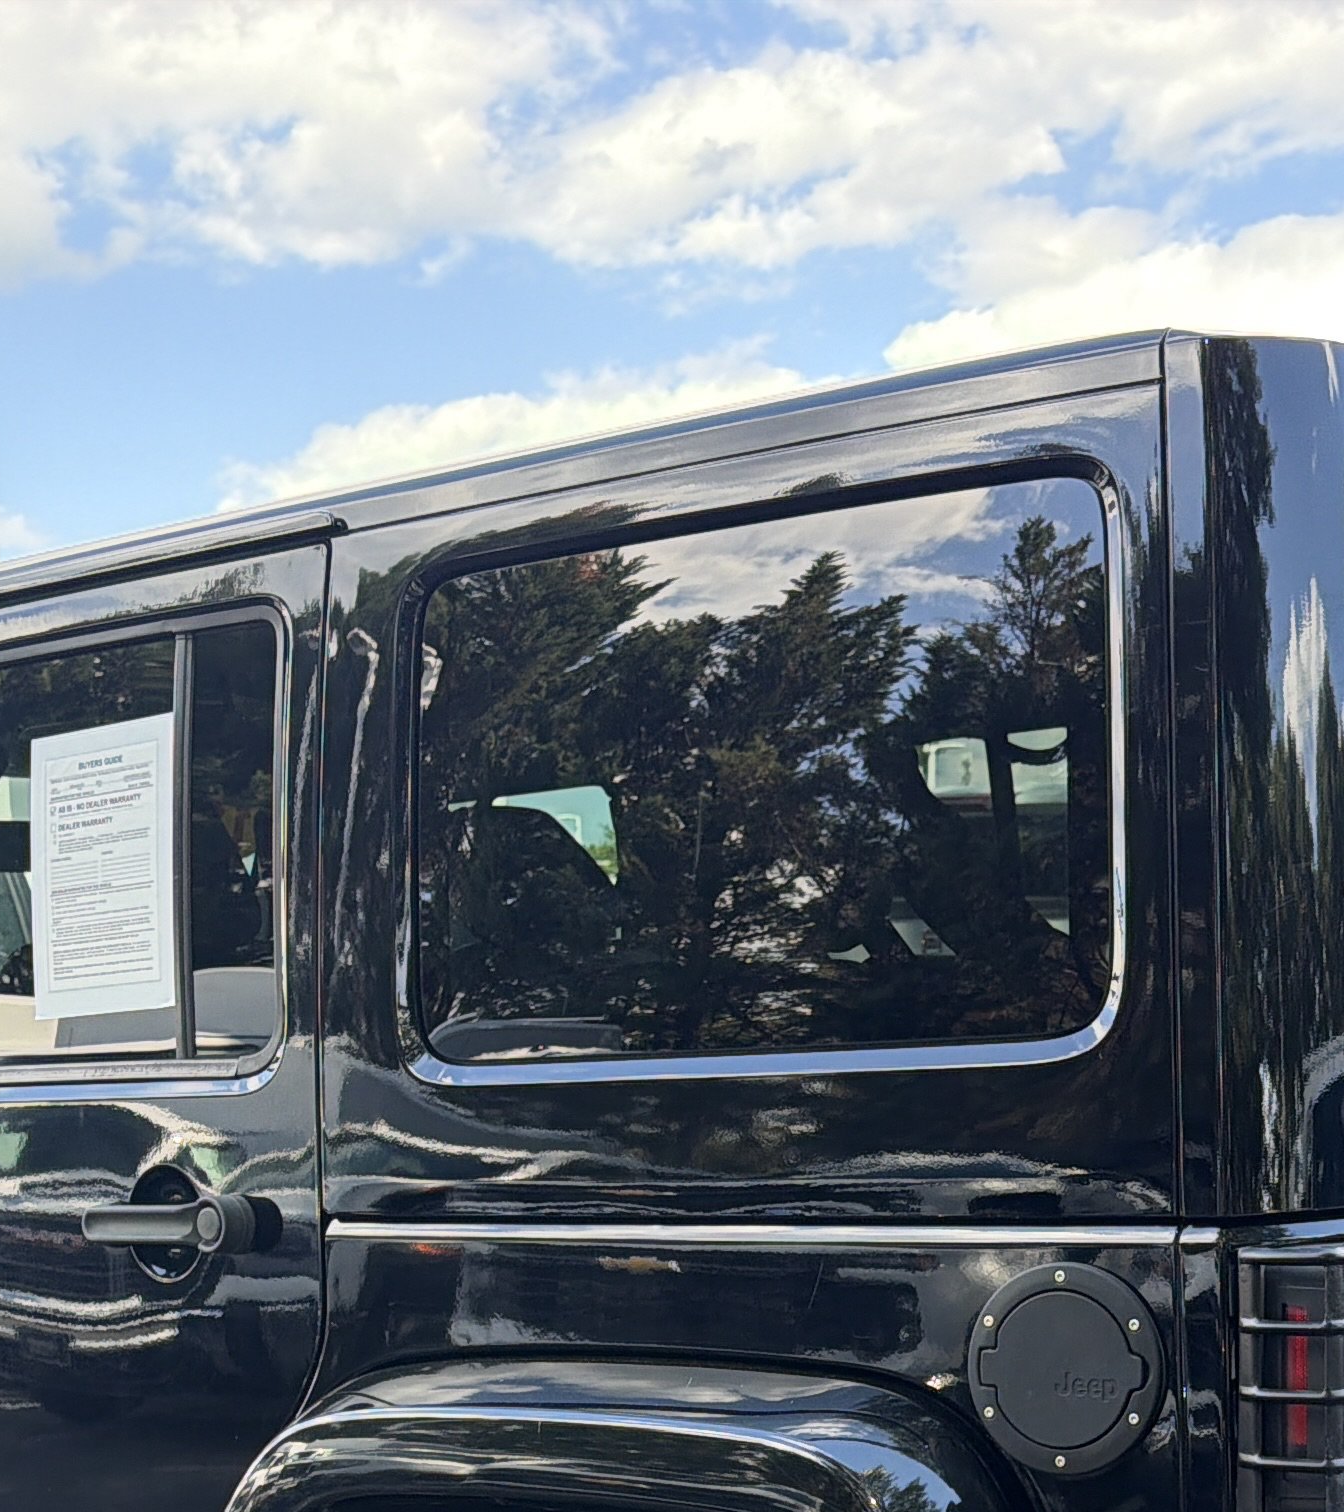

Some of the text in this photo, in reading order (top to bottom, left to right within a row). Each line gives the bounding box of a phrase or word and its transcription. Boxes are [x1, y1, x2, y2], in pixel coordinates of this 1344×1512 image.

[78, 754, 123, 771] BUYERS GUIDE
[58, 805, 66, 814] AS
[76, 801, 85, 811] NO
[86, 797, 109, 809] DEALER
[109, 793, 142, 805] WARRANTY
[58, 816, 113, 833] DEALER WARRANTY
[1054, 1371, 1119, 1403] Jeep
